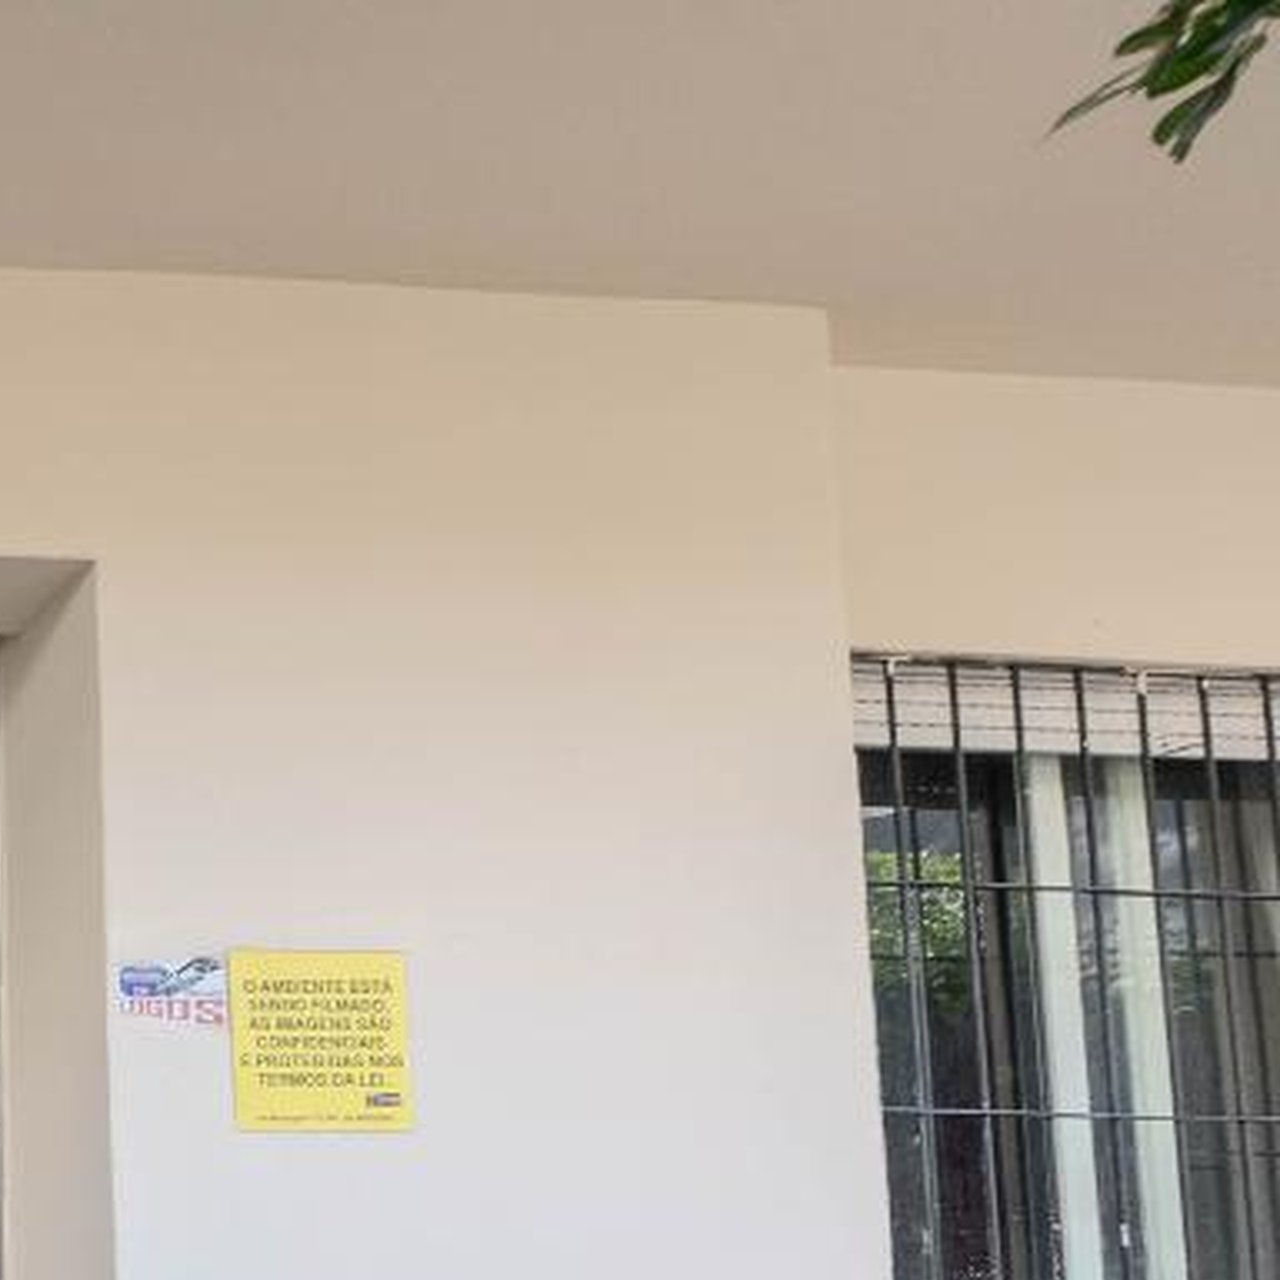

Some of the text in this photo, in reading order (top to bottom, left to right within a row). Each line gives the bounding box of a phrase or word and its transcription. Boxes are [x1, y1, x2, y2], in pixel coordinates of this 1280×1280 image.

[243, 980, 257, 994] O
[260, 980, 346, 994] AMBIENTE
[247, 999, 307, 1012] SENDO
[275, 1017, 352, 1031] IMAGENS
[256, 1053, 366, 1067] PROTEGIDAS
[257, 1073, 327, 1087] TERMOS
